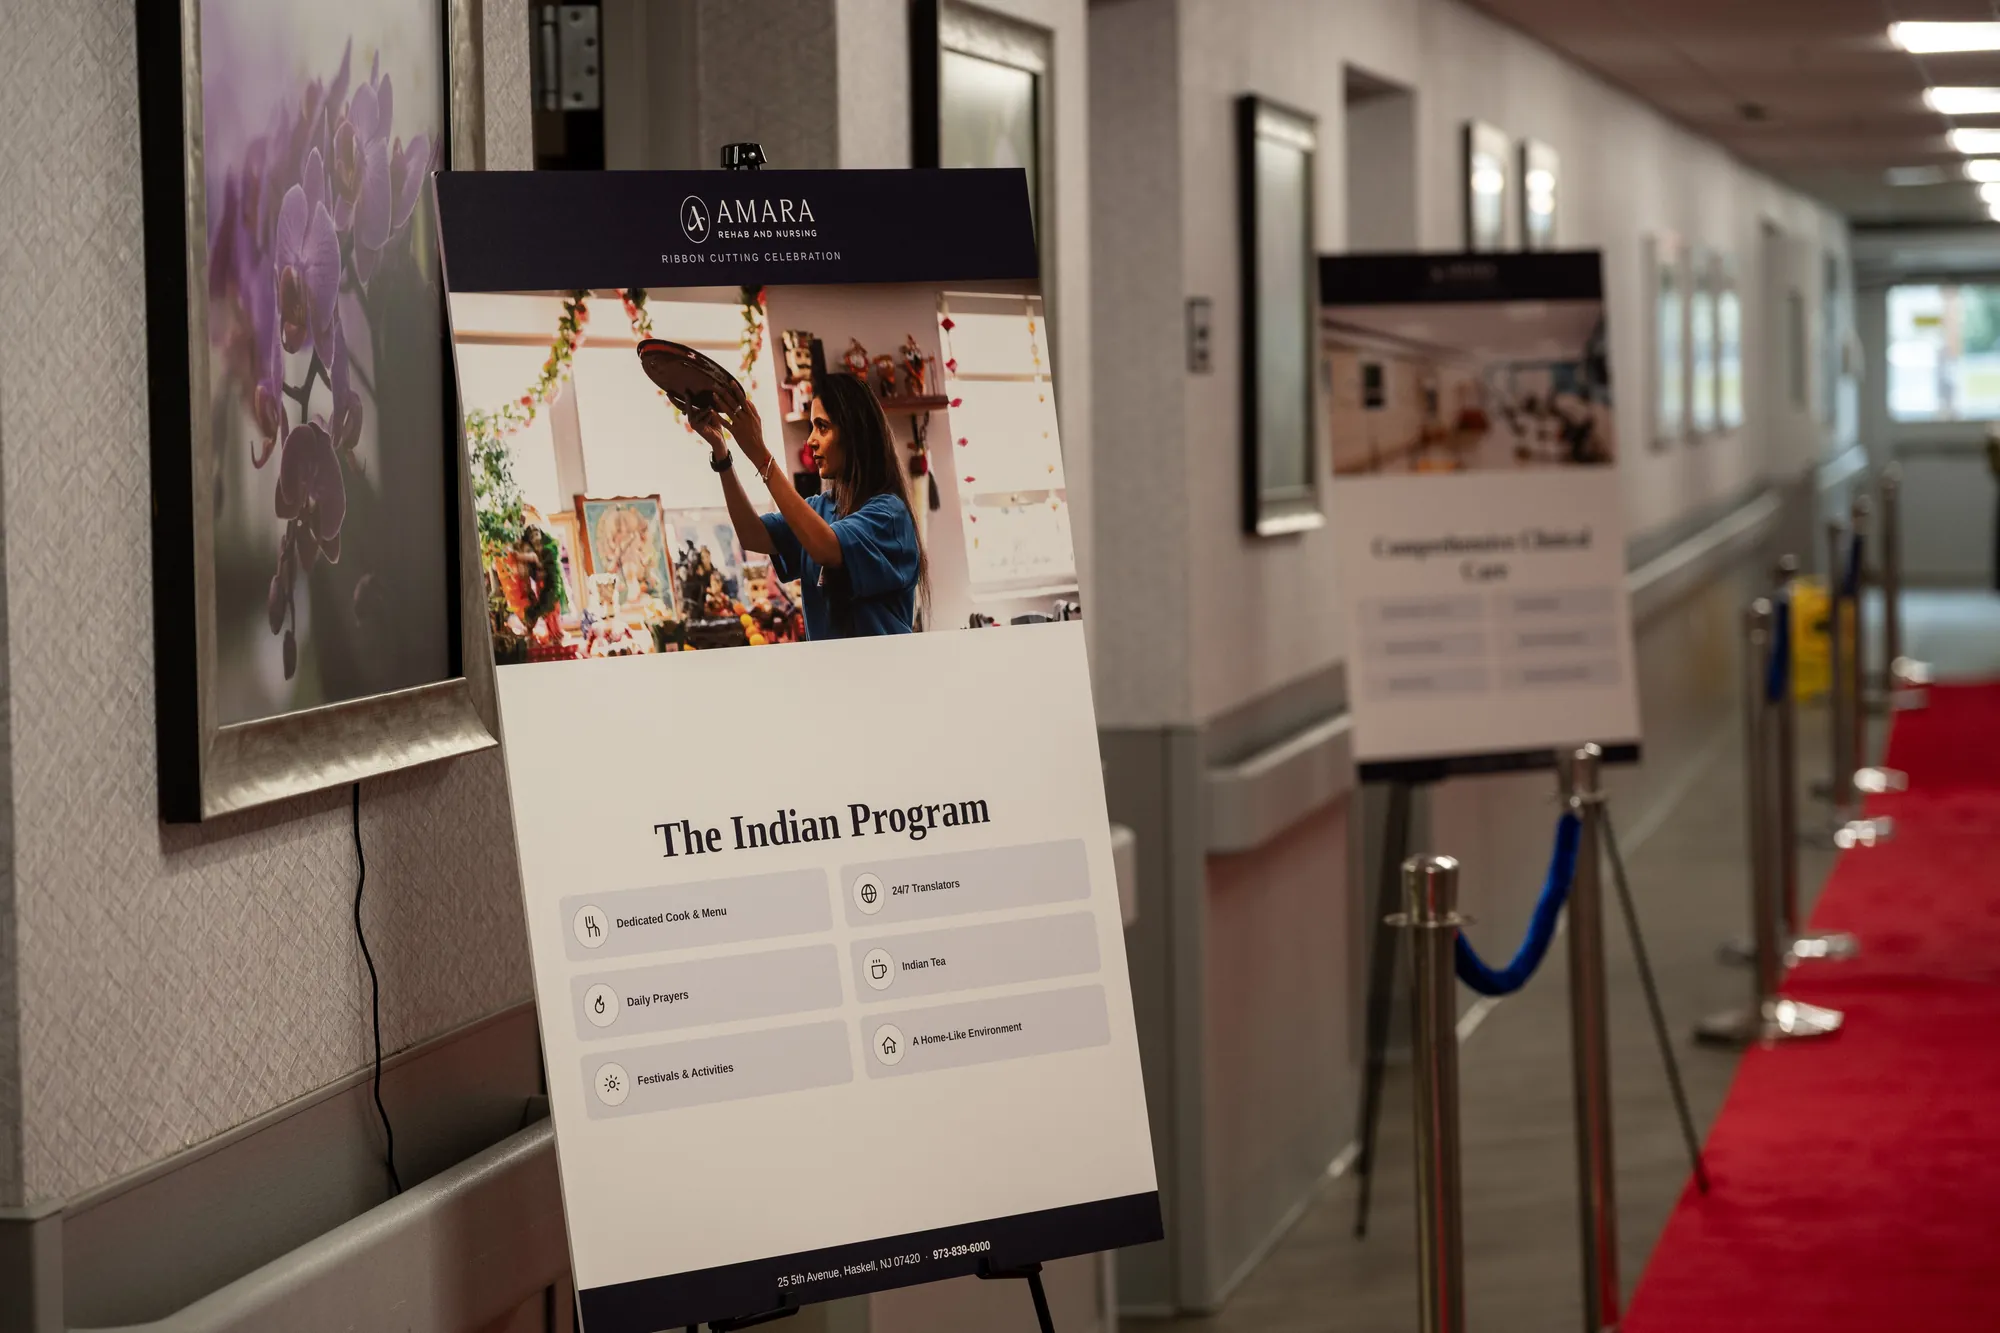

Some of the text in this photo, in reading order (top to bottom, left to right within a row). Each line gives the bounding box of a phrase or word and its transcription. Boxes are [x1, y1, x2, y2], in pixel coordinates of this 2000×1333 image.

[717, 198, 815, 224] AMARA
[718, 229, 817, 239] REHAB AND NURSING
[661, 251, 841, 263] RIBBON CUTTING CELEBRATION
[653, 799, 991, 858] The Indian Program
[892, 880, 960, 896] 24/7 Translators
[616, 907, 727, 928] Dedicated Cook & Menu
[902, 957, 946, 971] Indian Tea
[626, 990, 689, 1007] Daily Prayers
[912, 1022, 1022, 1047] A Home-Like Environment
[637, 1063, 734, 1086] Festivals & Activities
[777, 1240, 991, 1288] 25 5th Avenue, Haskell, NJ 07420 973-839-6000
